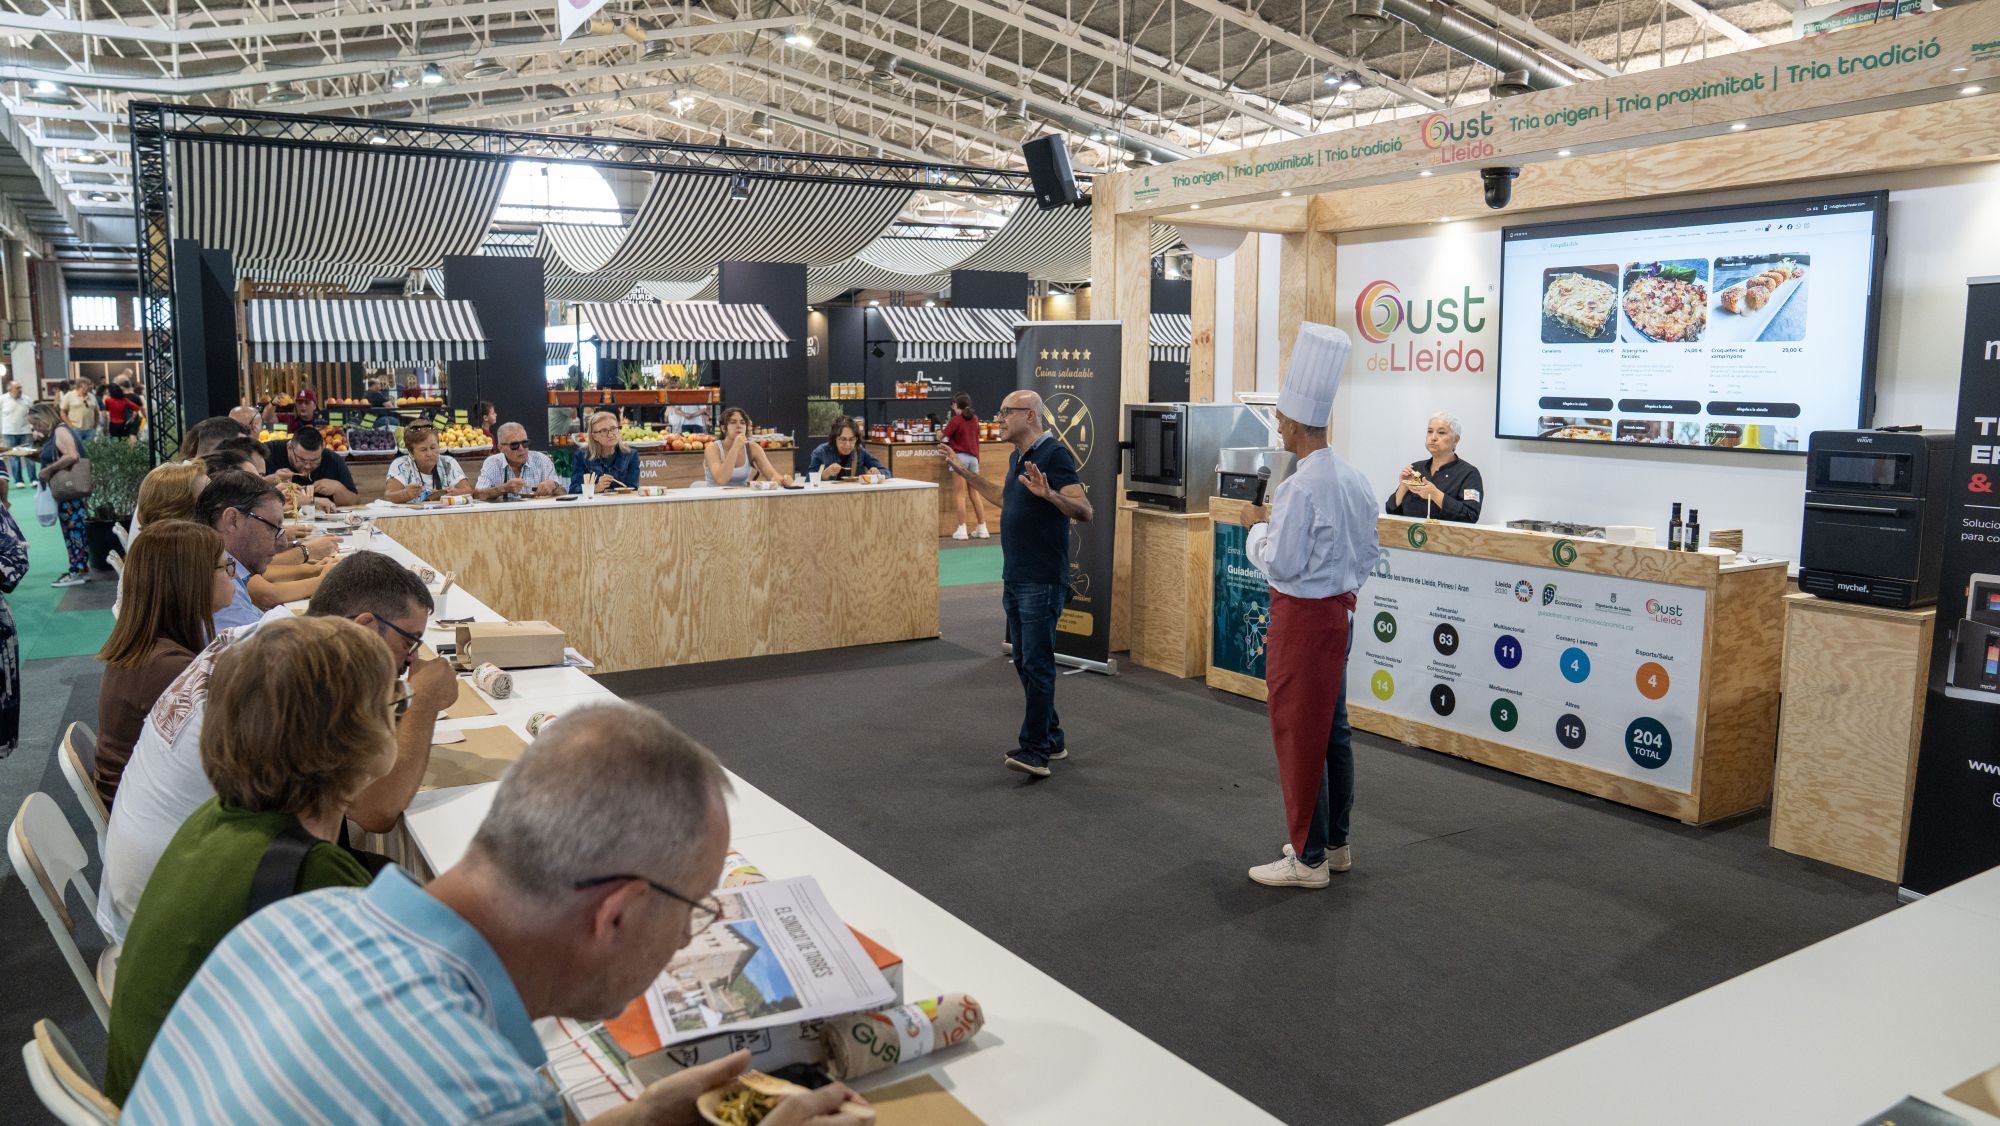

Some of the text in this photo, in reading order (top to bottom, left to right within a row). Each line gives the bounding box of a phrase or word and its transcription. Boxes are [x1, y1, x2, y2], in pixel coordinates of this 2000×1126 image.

[1786, 36, 1941, 83] Tria tradició
[1616, 72, 1765, 113] Tria proximitat
[1509, 105, 1599, 132] Tria origen
[1325, 136, 1403, 163] Tria tradició
[1441, 140, 1494, 164] Lleida
[1233, 152, 1314, 178] Tria proximitat
[1172, 170, 1224, 188] Tria origen
[1366, 339, 1485, 373] de Lleida
[1035, 366, 1094, 379] Cuina saludable
[645, 460, 667, 468] FINCA
[1961, 532, 1984, 543] para
[1438, 580, 1454, 590] Pirineu
[1457, 583, 1470, 592] Aran
[1495, 580, 1512, 589] Lleida
[1655, 614, 1682, 626] Lleida
[1493, 622, 1525, 634] Multisectorial
[1439, 632, 1453, 646] 63
[1555, 634, 1576, 644] Comerç
[1580, 638, 1598, 647] serveis
[1501, 645, 1515, 659] 11
[1570, 659, 1579, 672] 4
[1376, 679, 1388, 692] 14
[1648, 674, 1657, 688] 4
[1440, 694, 1445, 706] 1
[1564, 701, 1580, 709] Altres
[1500, 709, 1508, 721] 3
[1564, 724, 1580, 739] 15
[1633, 728, 1663, 748] 204
[1633, 746, 1661, 760] TOTAL
[774, 906, 793, 915] EL
[796, 941, 817, 952] DE
